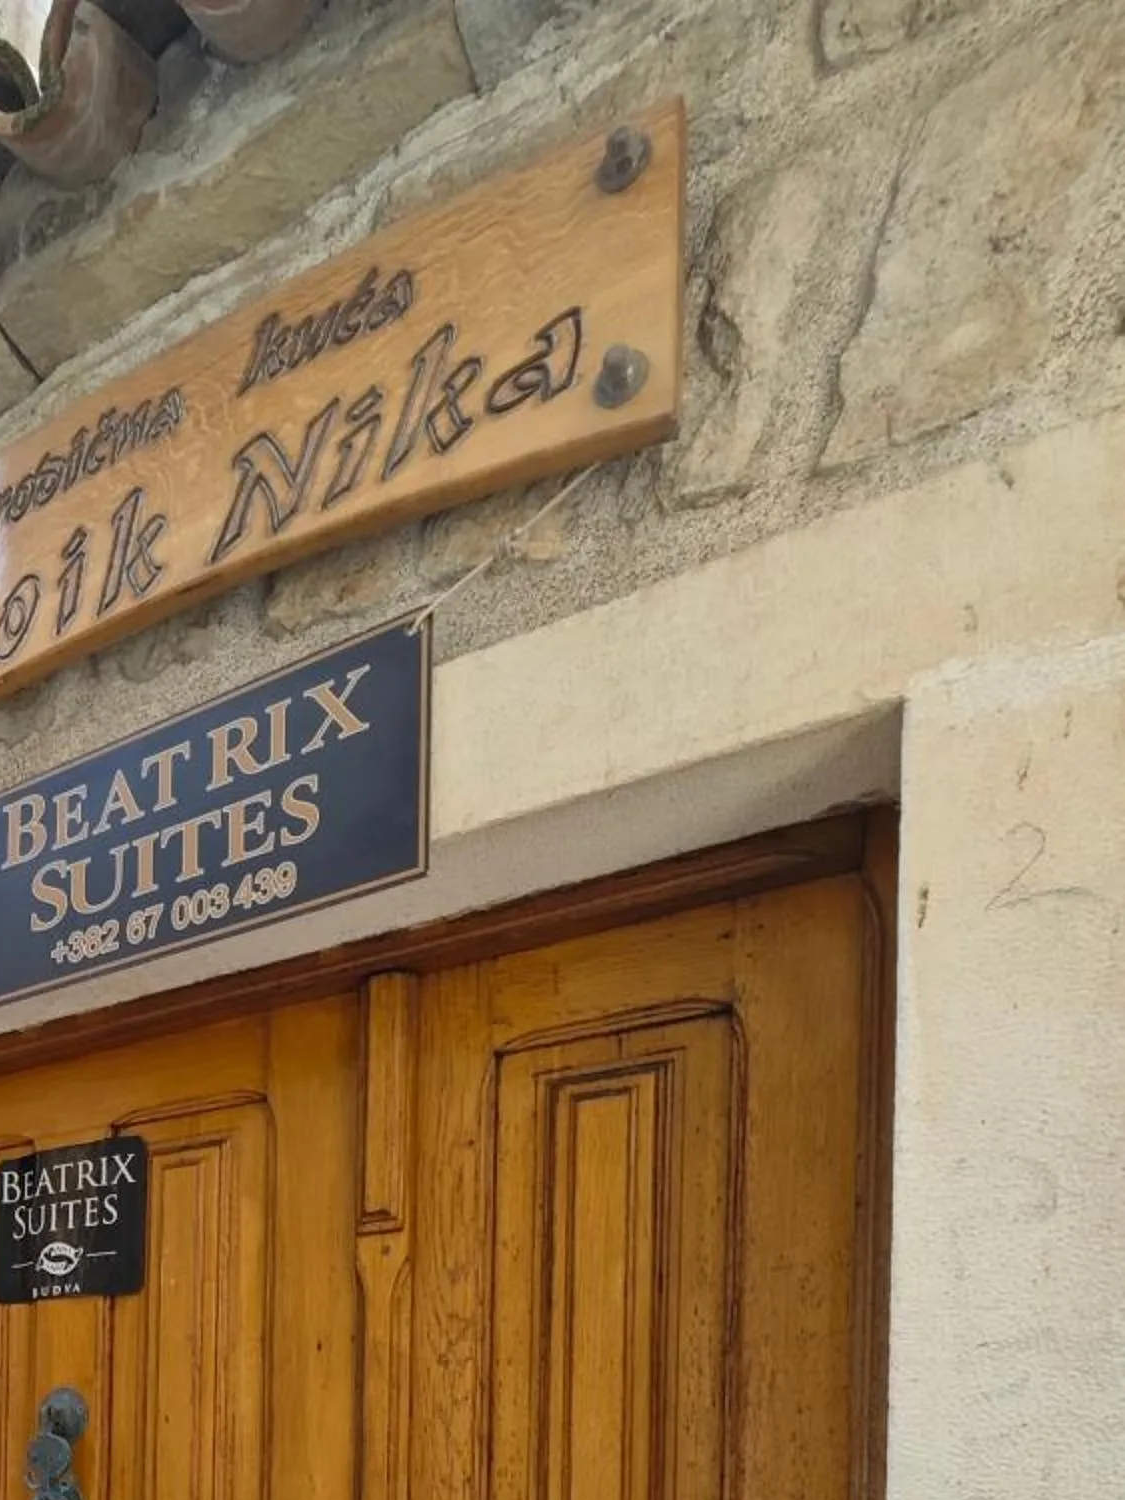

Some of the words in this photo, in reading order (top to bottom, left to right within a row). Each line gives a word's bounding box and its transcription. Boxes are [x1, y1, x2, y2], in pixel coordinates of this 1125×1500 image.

[209, 305, 582, 564] Nika
[0, 663, 371, 870] BEATRIX
[30, 773, 321, 932] SUITES
[50, 919, 121, 965] +382
[126, 903, 165, 945] 67
[171, 882, 231, 931] 003
[232, 860, 299, 910] 439
[1, 1153, 137, 1205] BEATRIX
[12, 1193, 119, 1241] SUITES
[32, 1283, 81, 1299] BUDVA
